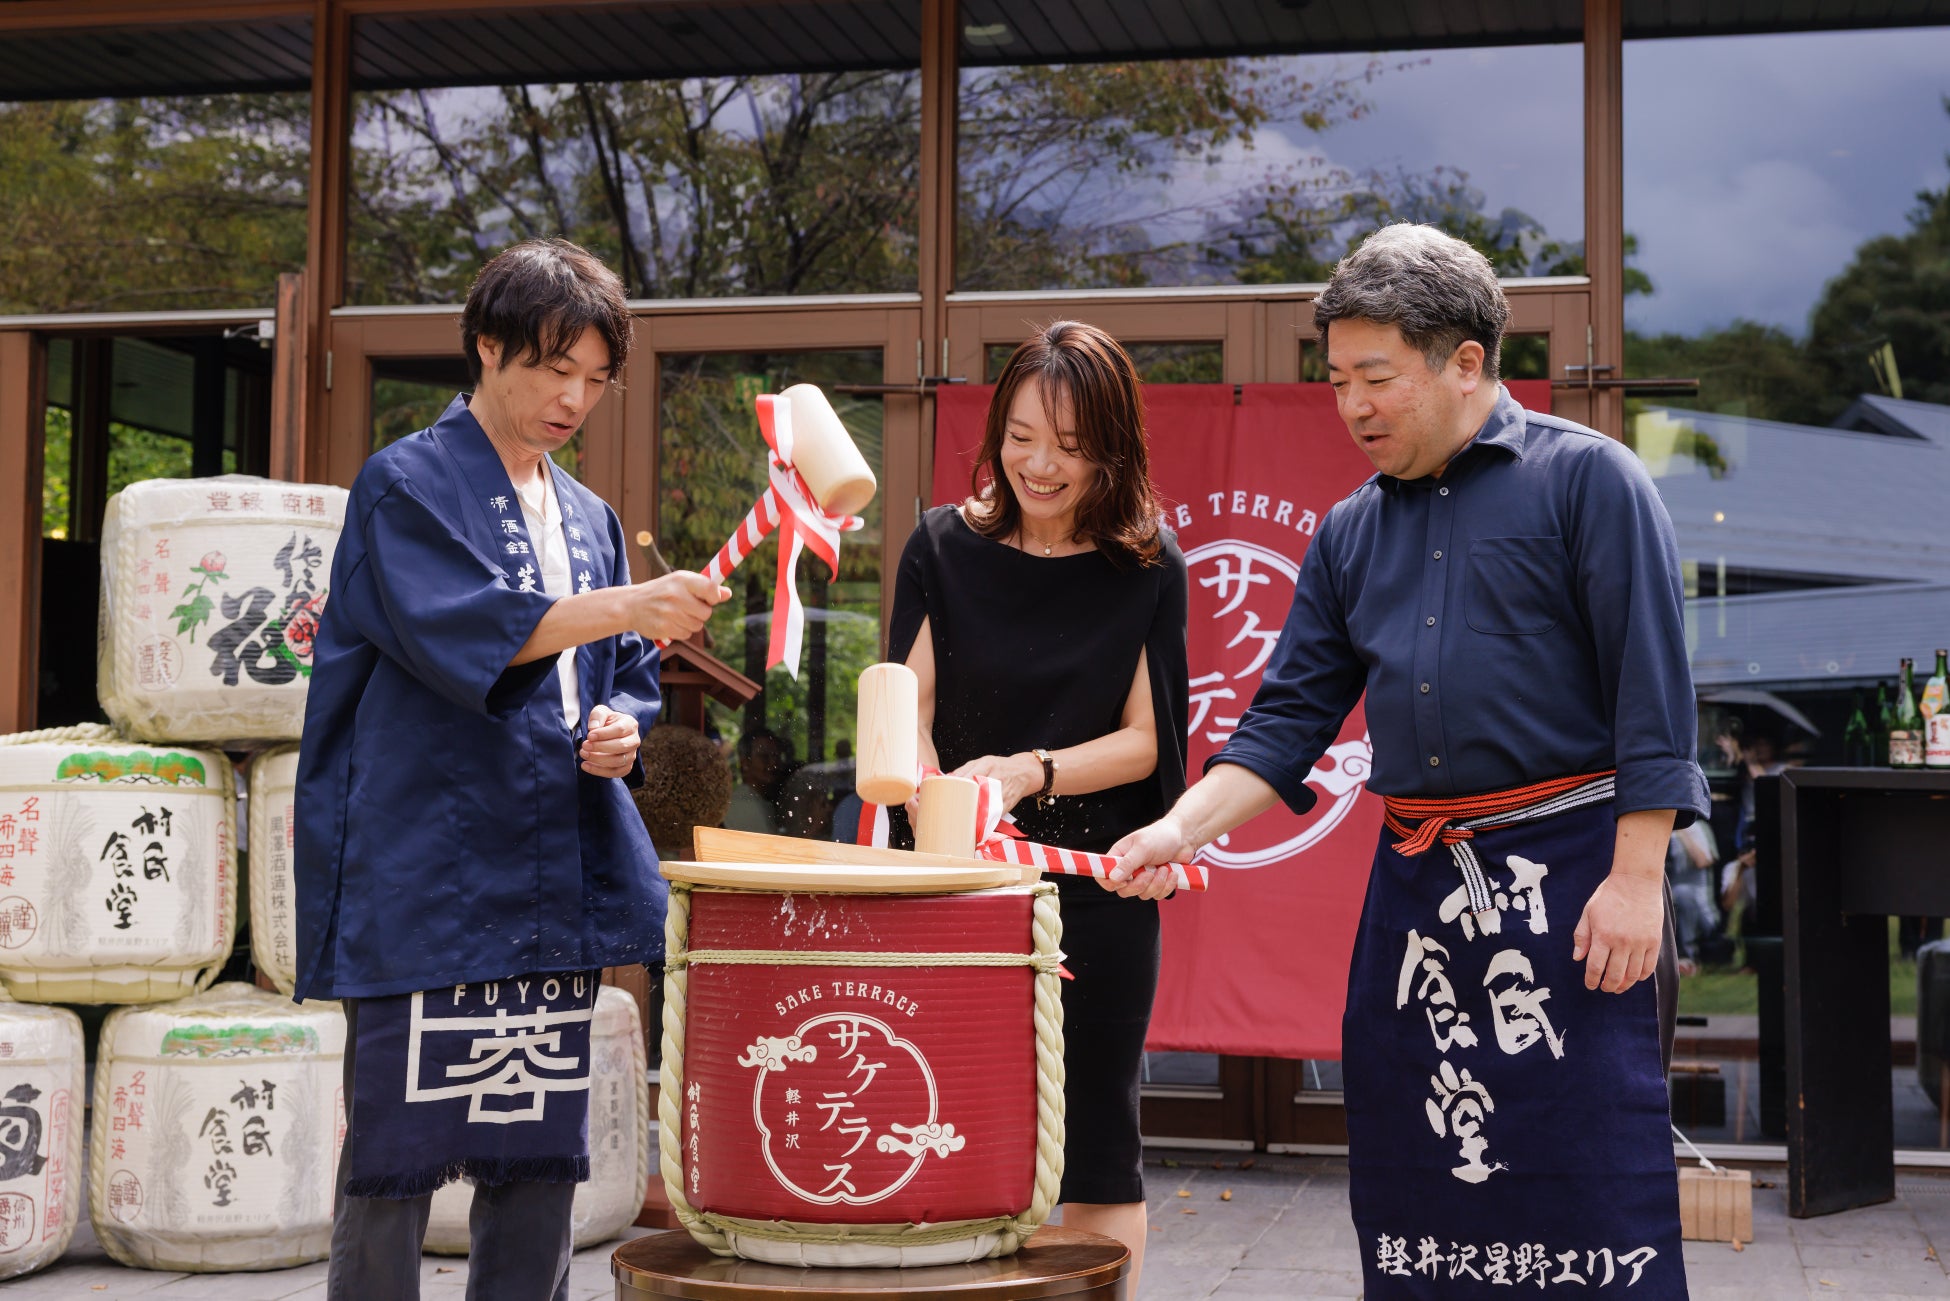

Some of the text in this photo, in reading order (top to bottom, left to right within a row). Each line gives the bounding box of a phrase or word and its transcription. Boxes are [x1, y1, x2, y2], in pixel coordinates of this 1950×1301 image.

[1208, 490, 1318, 537] TERRA
[1189, 548, 1283, 743] サケテ
[453, 975, 588, 1006] FUYOU
[775, 981, 919, 1018] SAKE TERRACE
[1397, 929, 1509, 1184] 食堂
[785, 1087, 802, 1149] 軽井沢
[815, 1020, 888, 1195] サケテラス
[1376, 1232, 1658, 1290] 軽井沢星野エリア
